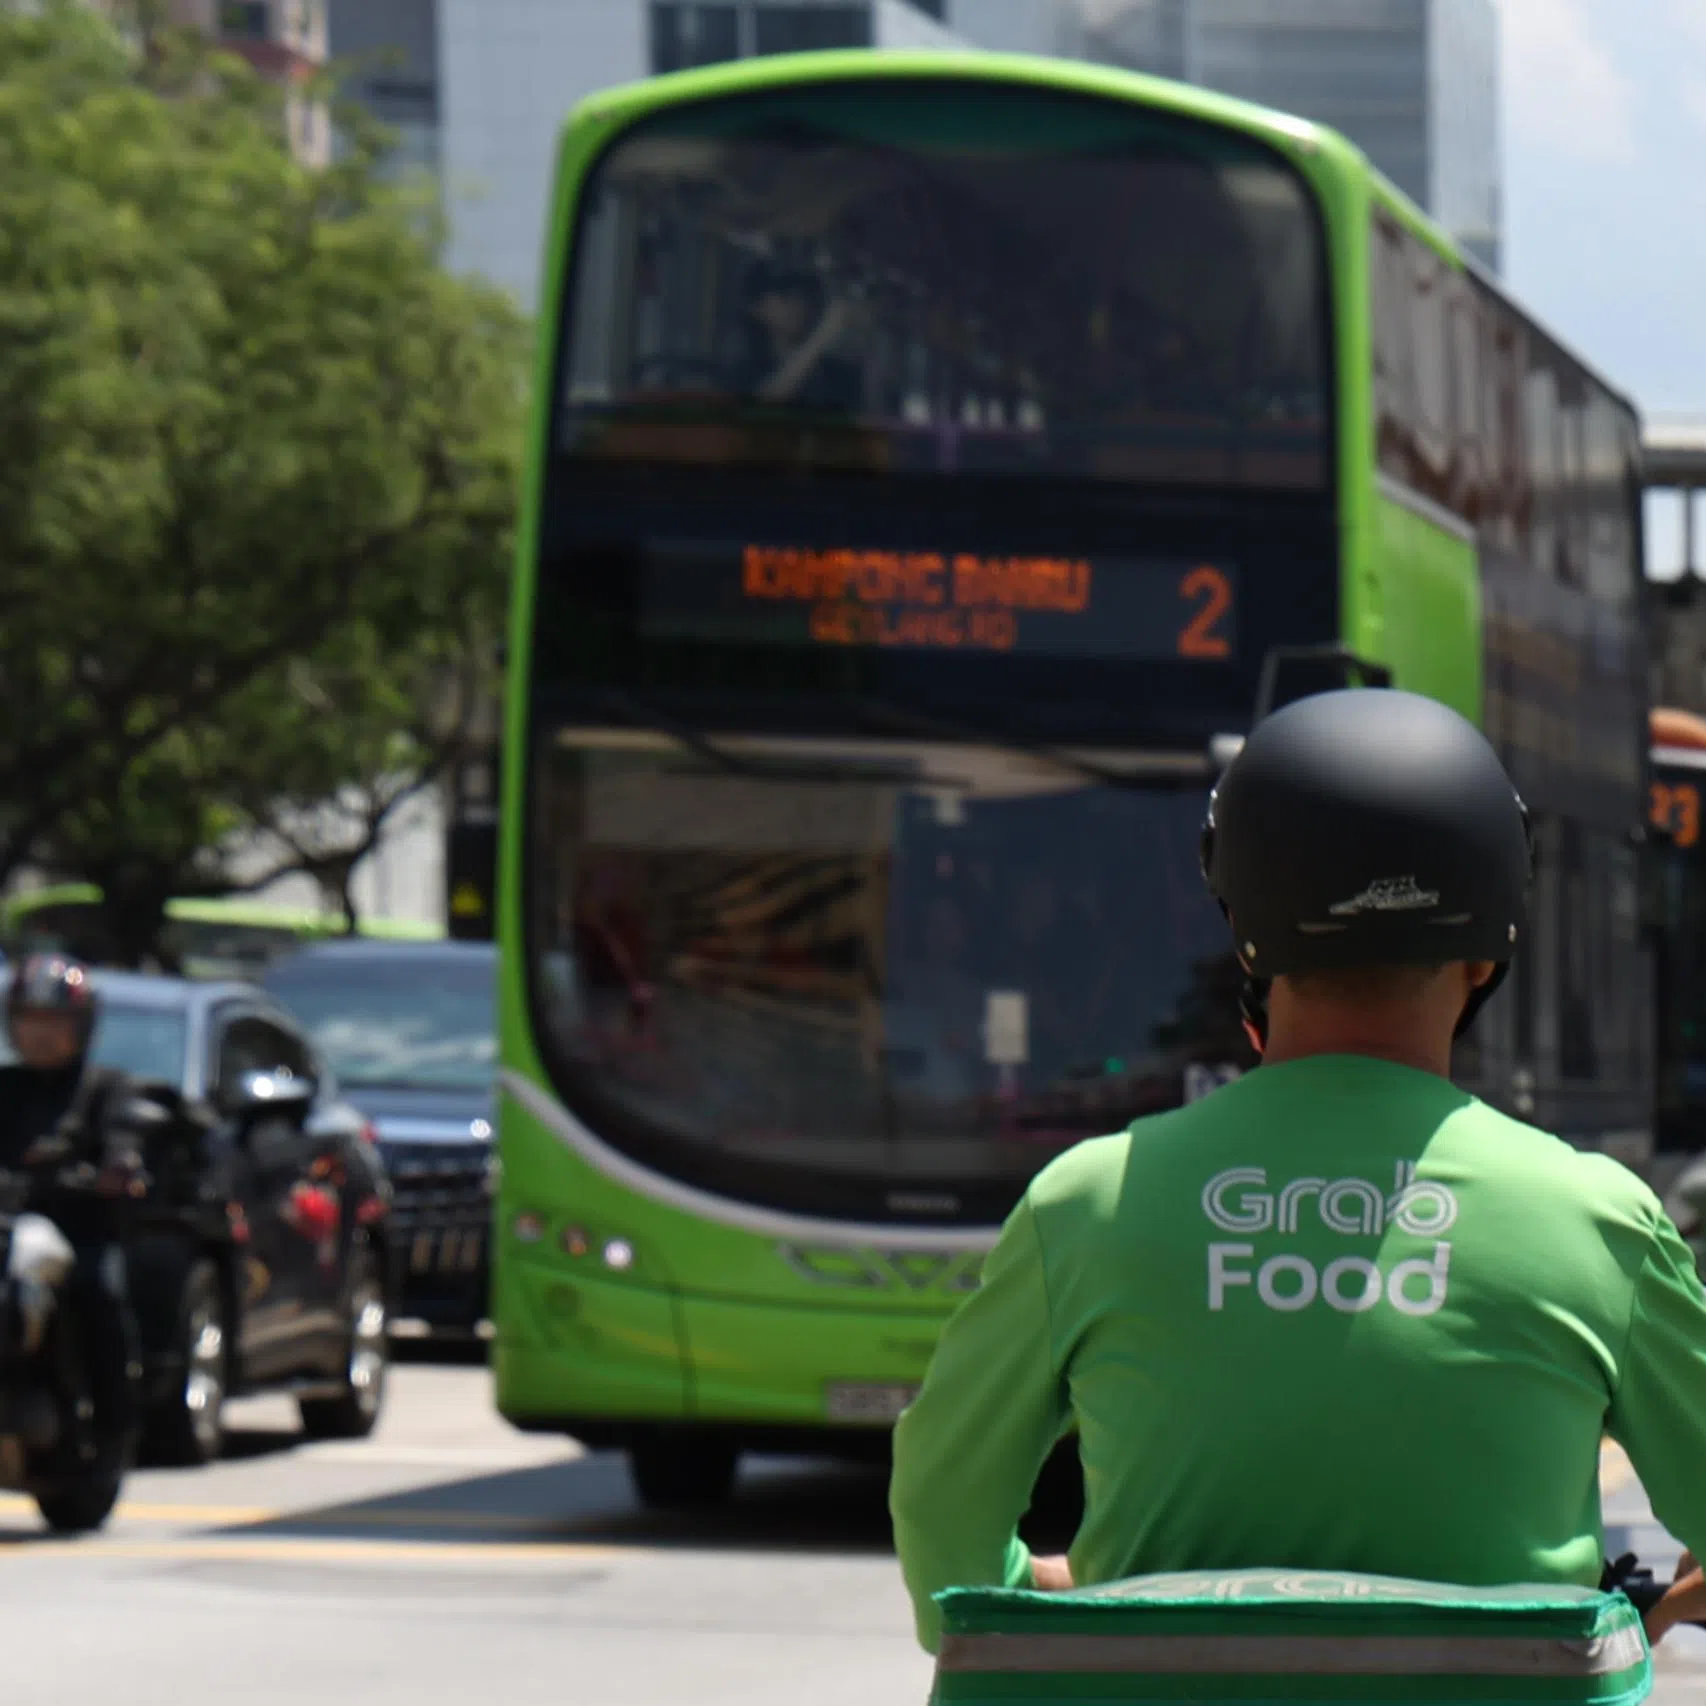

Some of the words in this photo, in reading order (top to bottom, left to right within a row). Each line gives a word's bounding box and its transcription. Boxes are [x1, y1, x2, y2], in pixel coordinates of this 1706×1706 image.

[1176, 564, 1232, 657] 2
[1201, 1160, 1458, 1236] Grab
[1207, 1241, 1452, 1317] Food
